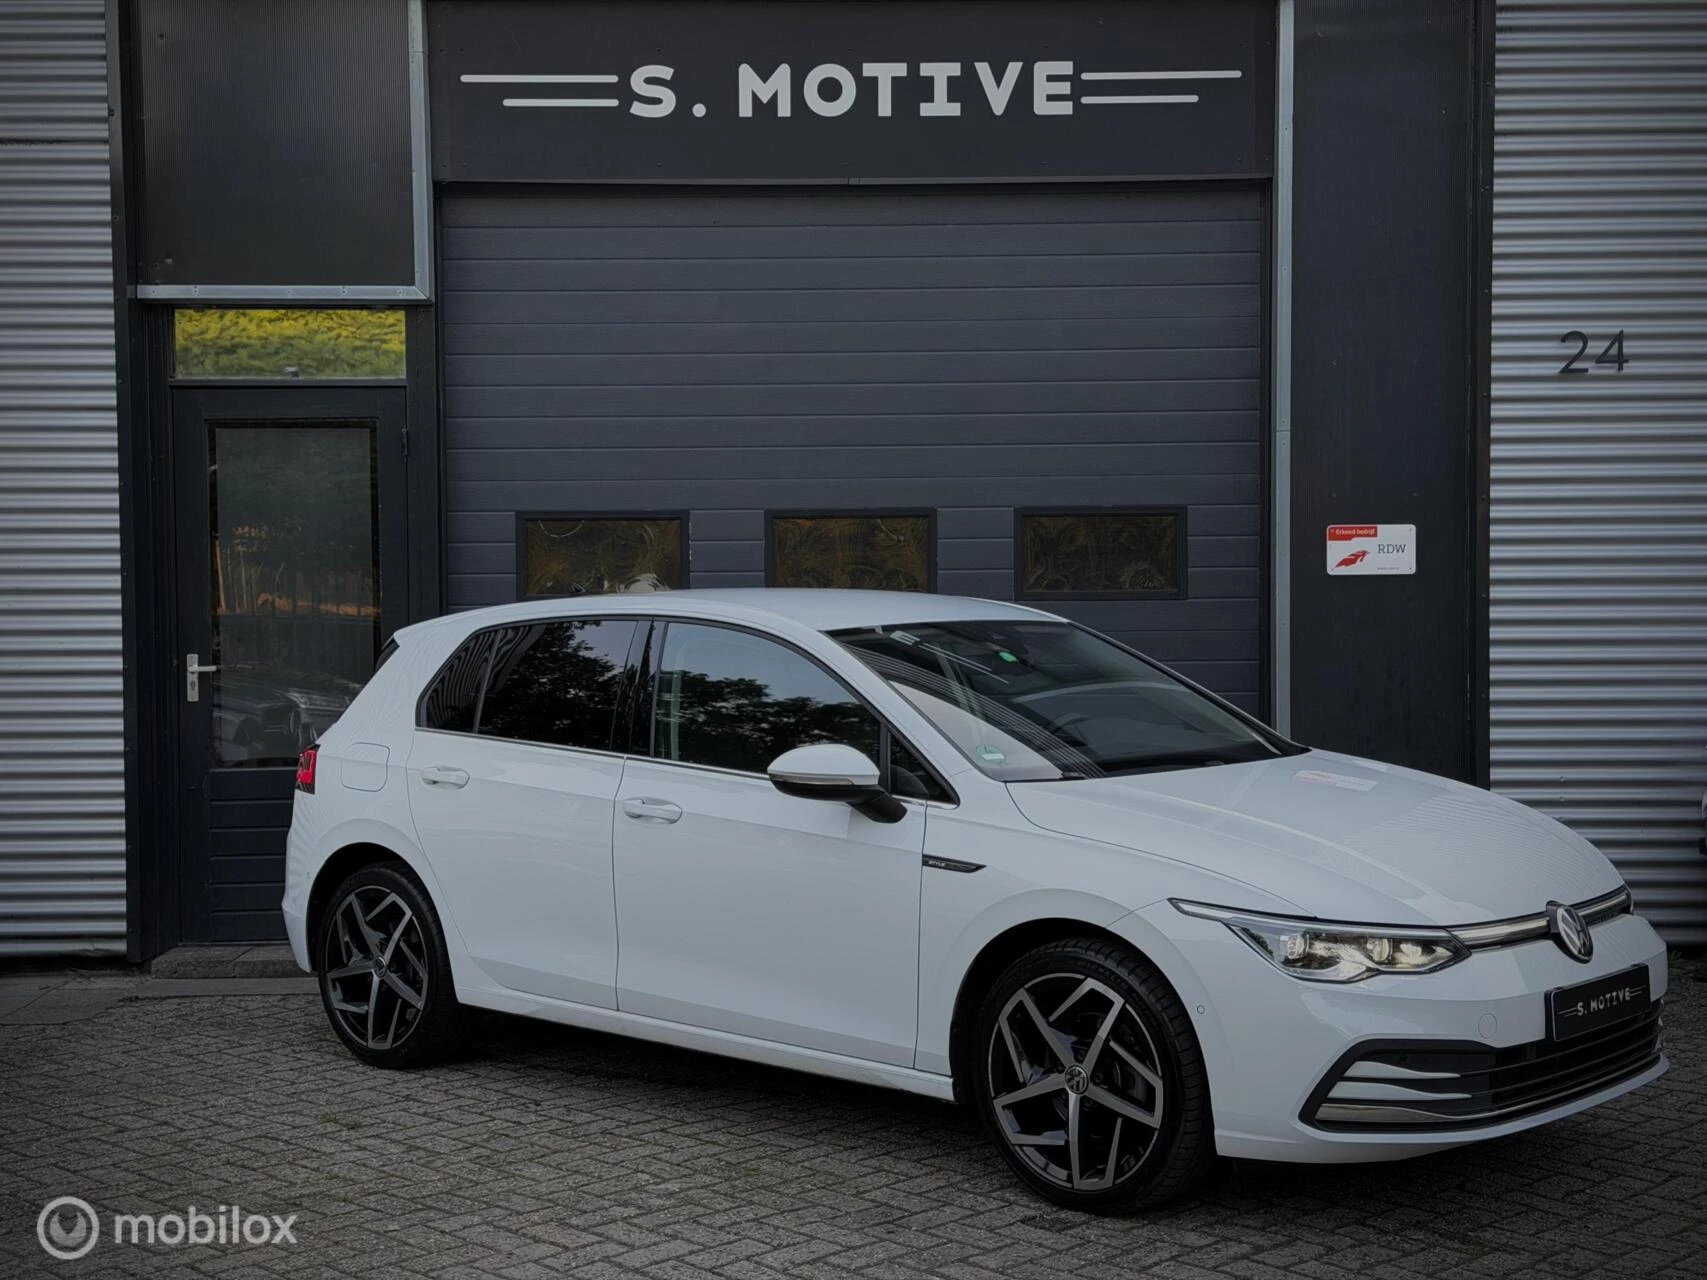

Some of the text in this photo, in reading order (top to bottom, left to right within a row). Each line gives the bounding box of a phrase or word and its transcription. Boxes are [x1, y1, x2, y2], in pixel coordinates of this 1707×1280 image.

[629, 60, 1074, 119] S. MOTIVE
[1558, 329, 1630, 374] 24
[1377, 543, 1407, 554] RDW
[1577, 988, 1631, 1016] S. MOTIVE
